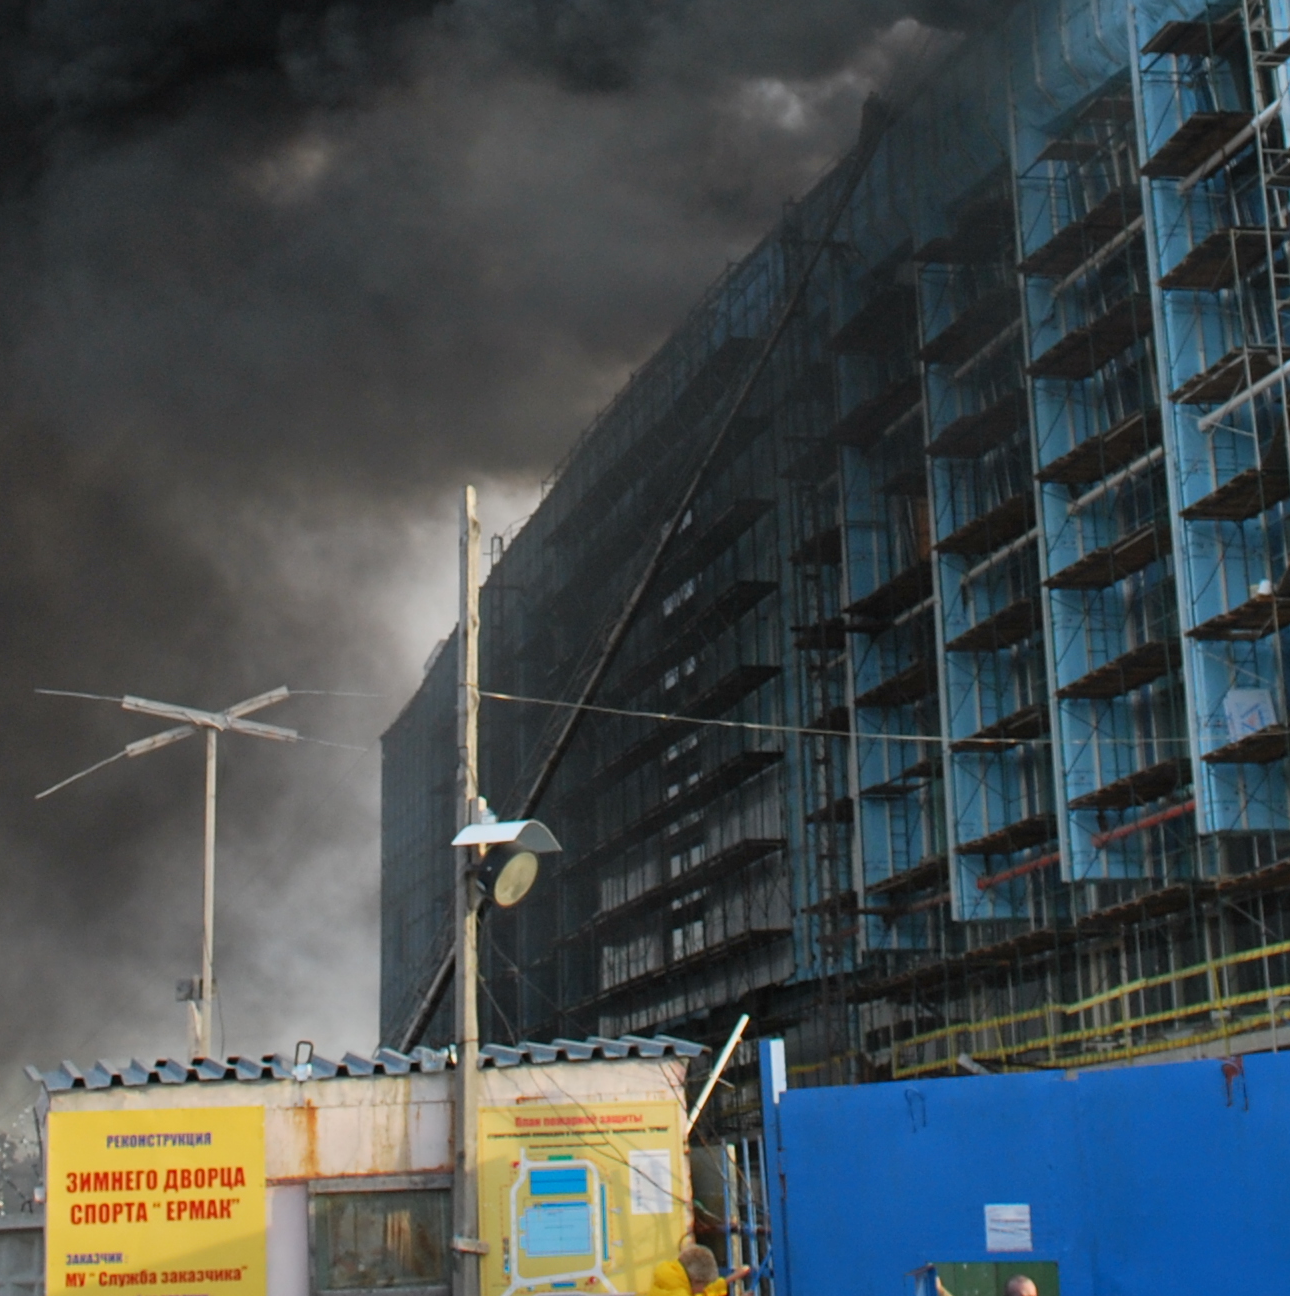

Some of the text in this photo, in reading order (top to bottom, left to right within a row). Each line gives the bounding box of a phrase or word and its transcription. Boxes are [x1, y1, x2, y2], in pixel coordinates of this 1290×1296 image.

[106, 1132, 212, 1149] РЕКОНСТРУКЦИЯ
[66, 1167, 246, 1193] ЗИМНЕГО ДВОРЦА
[70, 1202, 148, 1225] СПОРТА
[65, 1272, 86, 1287] МУ
